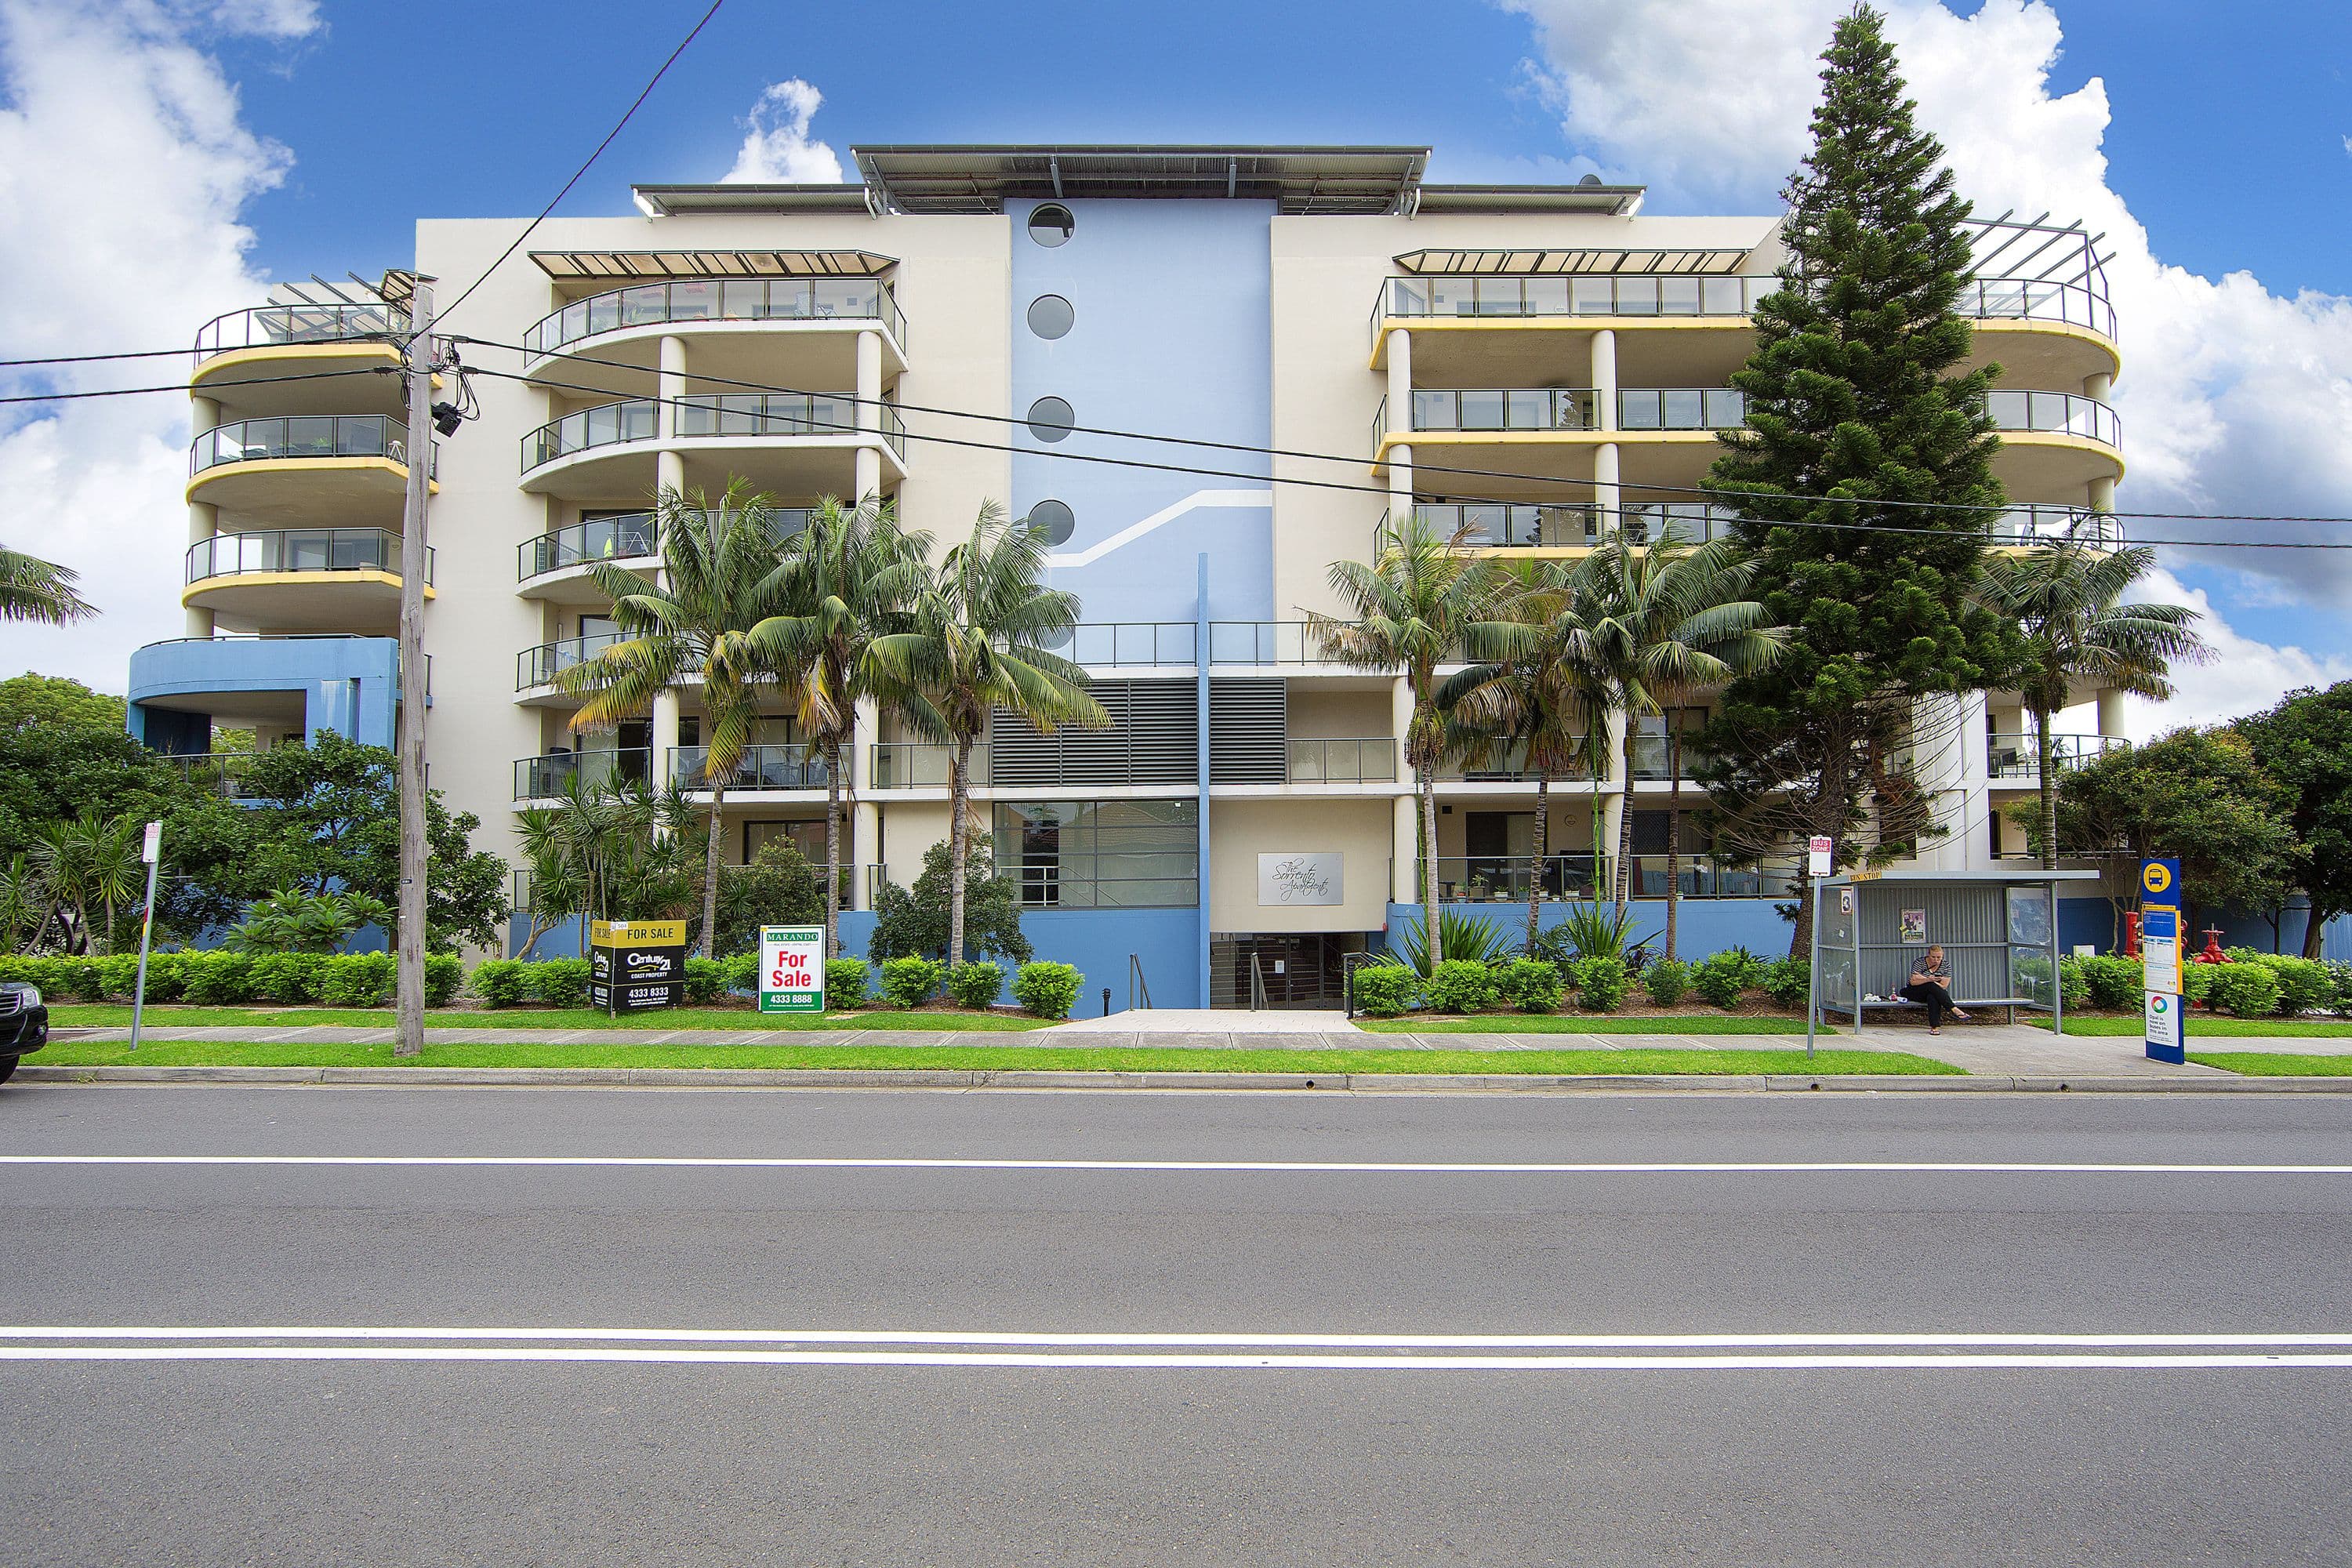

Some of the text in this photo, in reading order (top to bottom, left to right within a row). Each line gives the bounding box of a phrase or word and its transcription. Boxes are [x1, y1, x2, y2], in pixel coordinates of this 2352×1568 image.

[1282, 858, 1304, 873] The
[1272, 864, 1316, 883] Sorrento
[602, 928, 611, 938] SALE
[627, 927, 673, 939] FOR SALE
[659, 959, 671, 971] 21
[779, 951, 808, 967] For
[772, 970, 811, 987] Sale
[629, 986, 669, 998] 4333 8333
[771, 994, 812, 1004] 4333 8888
